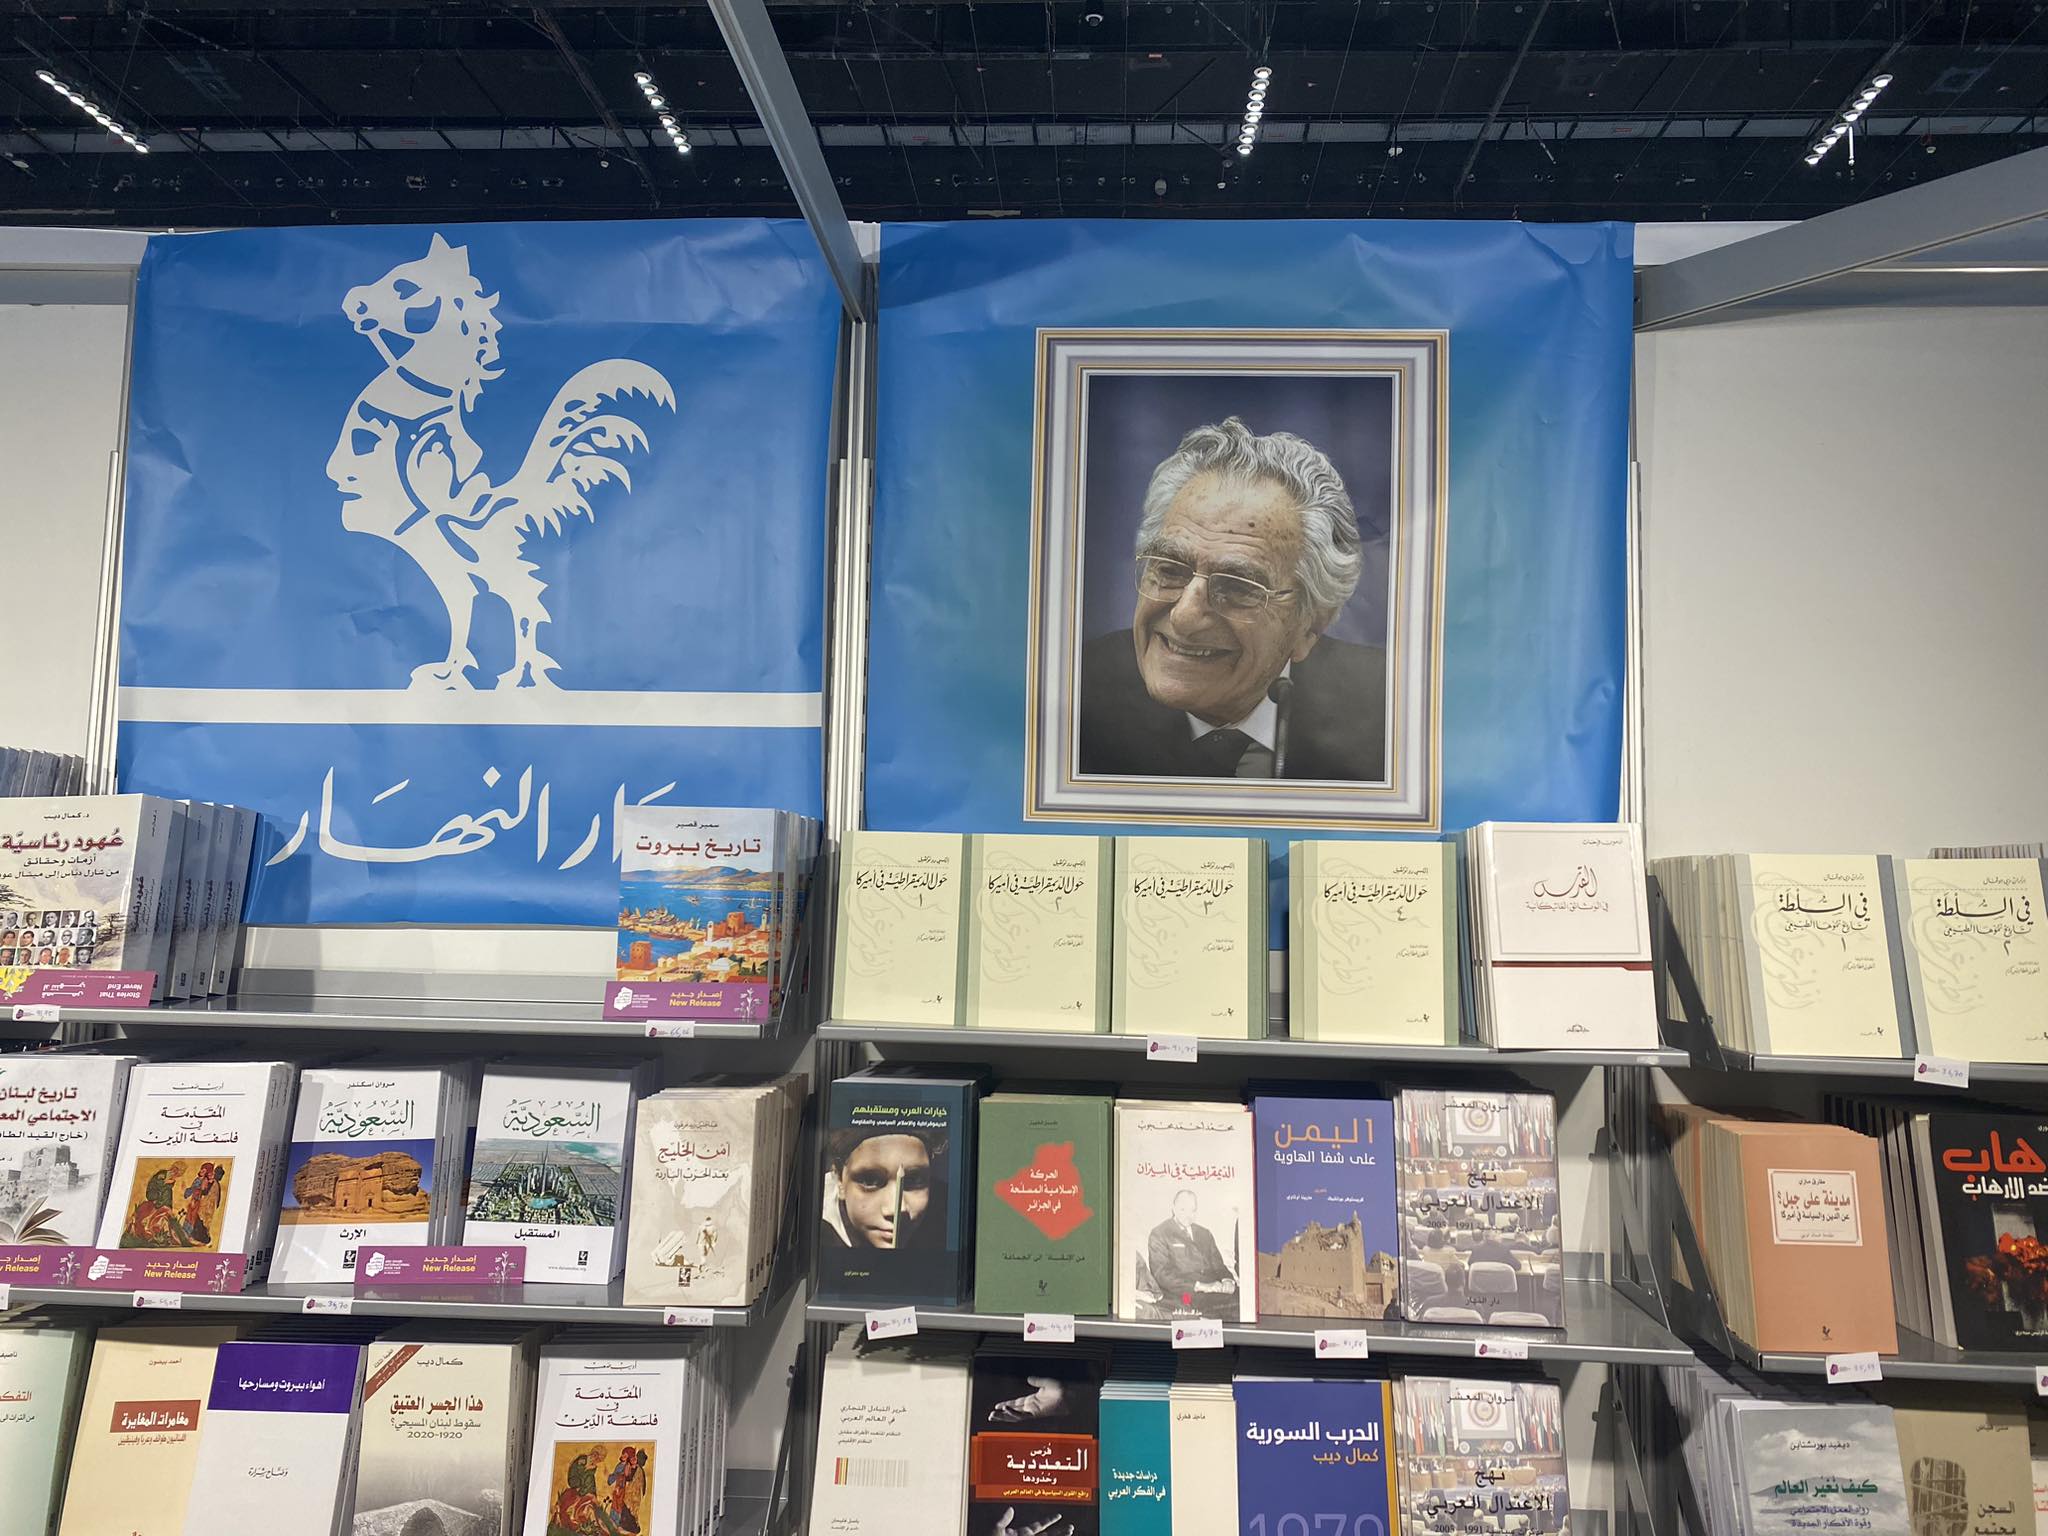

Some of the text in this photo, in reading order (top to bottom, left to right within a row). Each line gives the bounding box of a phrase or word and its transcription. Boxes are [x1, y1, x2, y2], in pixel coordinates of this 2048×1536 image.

[264, 764, 550, 867] النهار
[676, 820, 719, 829] سمير قصير
[636, 835, 761, 858] تاريخ بيروت
[1855, 892, 1871, 921] في
[2016, 895, 2034, 925] في
[116, 991, 141, 999] Stories
[671, 990, 723, 999] إصدار جديد
[669, 999, 722, 1007] New Release
[38, 1087, 78, 1104] تاريخ
[852, 1105, 947, 1117] خيارات العرب ومستقبلهم
[1481, 1103, 1510, 1112] مروان
[27, 1107, 96, 1126] الاجتماعي
[27, 1131, 57, 1140] القيد
[1274, 1118, 1373, 1149] اليمن
[1274, 1150, 1376, 1165] على شفا الهاوية
[1030, 1169, 1058, 1179] الحركة
[1467, 1168, 1497, 1188] نهج
[1420, 1194, 1540, 1215] الاعتدال العربي
[1803, 1191, 1820, 1209] على
[1823, 1190, 1851, 1211] مدينة
[1027, 1199, 1061, 1214] في الجزائر
[1796, 1211, 1802, 1222] في
[1802, 1211, 1825, 1221] والسياسة
[1826, 1212, 1840, 1222] الدين
[1841, 1214, 1850, 1222] عن
[340, 1229, 367, 1240] الإرث
[514, 1228, 560, 1240] المستقبل
[13, 1255, 41, 1264] إصدار
[146, 1260, 198, 1270] إصدار جديد
[423, 1254, 477, 1264] إصدار جديد
[6, 1264, 39, 1272] Release
[422, 1264, 476, 1272] New Release
[144, 1270, 197, 1279] New Release
[1465, 1297, 1500, 1307] دار النهار
[416, 1357, 463, 1367] كمال ديب
[238, 1377, 279, 1392] ومسارحها
[279, 1379, 305, 1392] بيروت
[390, 1394, 484, 1415] هذا الجسر العتيق
[1487, 1393, 1515, 1404] مروان
[121, 1411, 189, 1429] مغامرات المغايرة
[429, 1419, 451, 1429] لبنان
[454, 1418, 481, 1431] سقوط
[865, 1415, 886, 1423] العالم
[1246, 1421, 1379, 1445] الحرب السورية
[1828, 1440, 1850, 1450] ديفيد
[1006, 1448, 1088, 1472] التعددية
[1312, 1448, 1379, 1465] كمال ديب
[1112, 1468, 1158, 1483] دراسات جديدة
[1474, 1466, 1505, 1488] نهج
[1003, 1488, 1019, 1496] العربي
[1034, 1489, 1041, 1497] في
[1042, 1489, 1063, 1497] السياسية
[1108, 1485, 1166, 1501] في الفكر العربي
[1775, 1479, 1808, 1498] العالم
[1842, 1479, 1878, 1498] كيف
[1427, 1495, 1550, 1519] الاعتدال العربي
[1977, 1500, 2016, 1518] السجن
